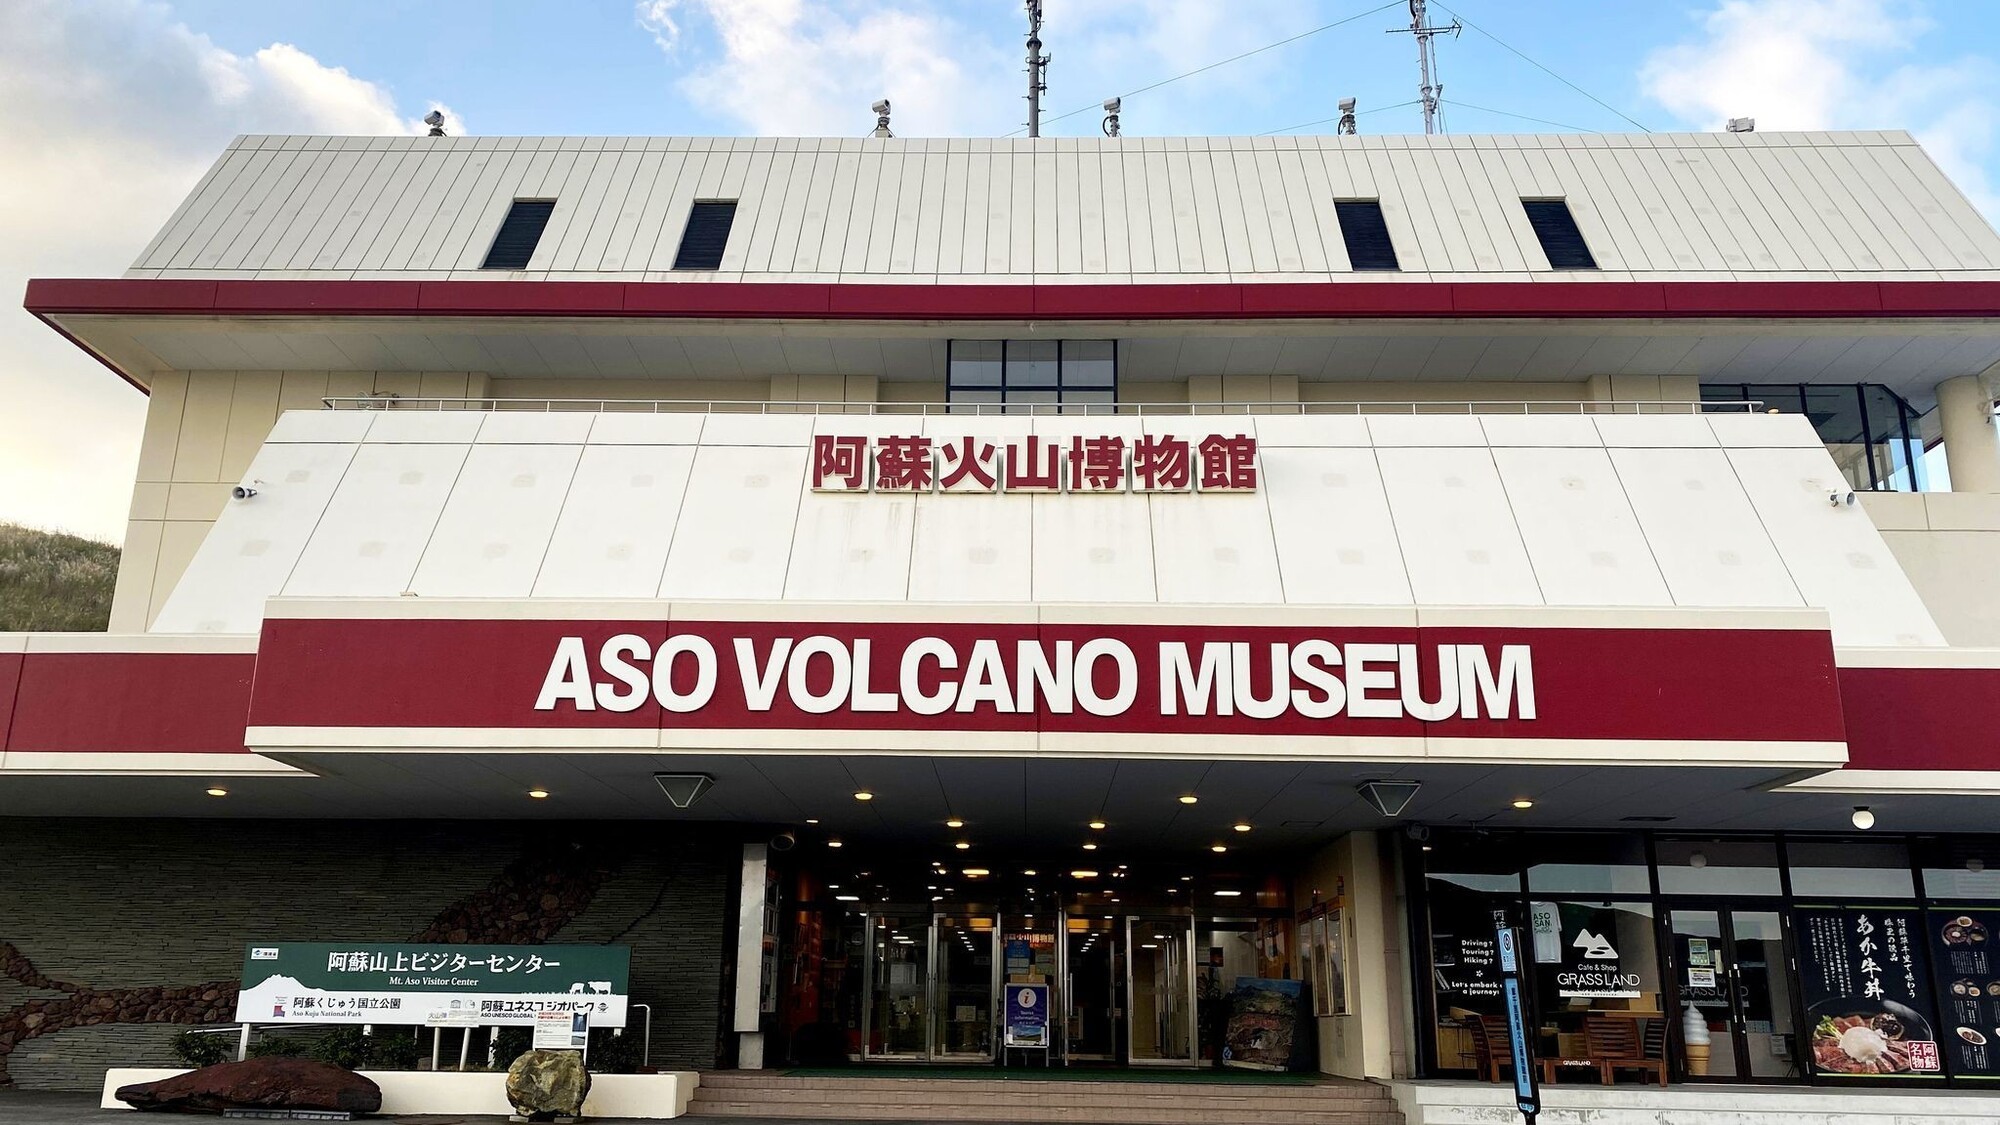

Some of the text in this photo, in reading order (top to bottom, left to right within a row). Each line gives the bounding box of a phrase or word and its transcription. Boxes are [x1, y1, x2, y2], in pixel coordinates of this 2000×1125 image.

[814, 435, 1256, 492] 阿蘇火山博物館
[534, 635, 1537, 721] ASO VOLCANO MUSEUM
[1533, 912, 1550, 920] ASO
[327, 951, 561, 974] 阿蘇山上ビジターセンター
[1856, 914, 1885, 1001] あか牛丼
[1577, 963, 1618, 973] Cafe & Shop
[389, 976, 479, 987] Mt. Aso Visitor Center
[1557, 973, 1641, 988] GRASSLAND
[293, 997, 402, 1009] 阿蘇くじゅう国立公園
[304, 1010, 320, 1018] Kuju
[320, 1010, 347, 1018] National
